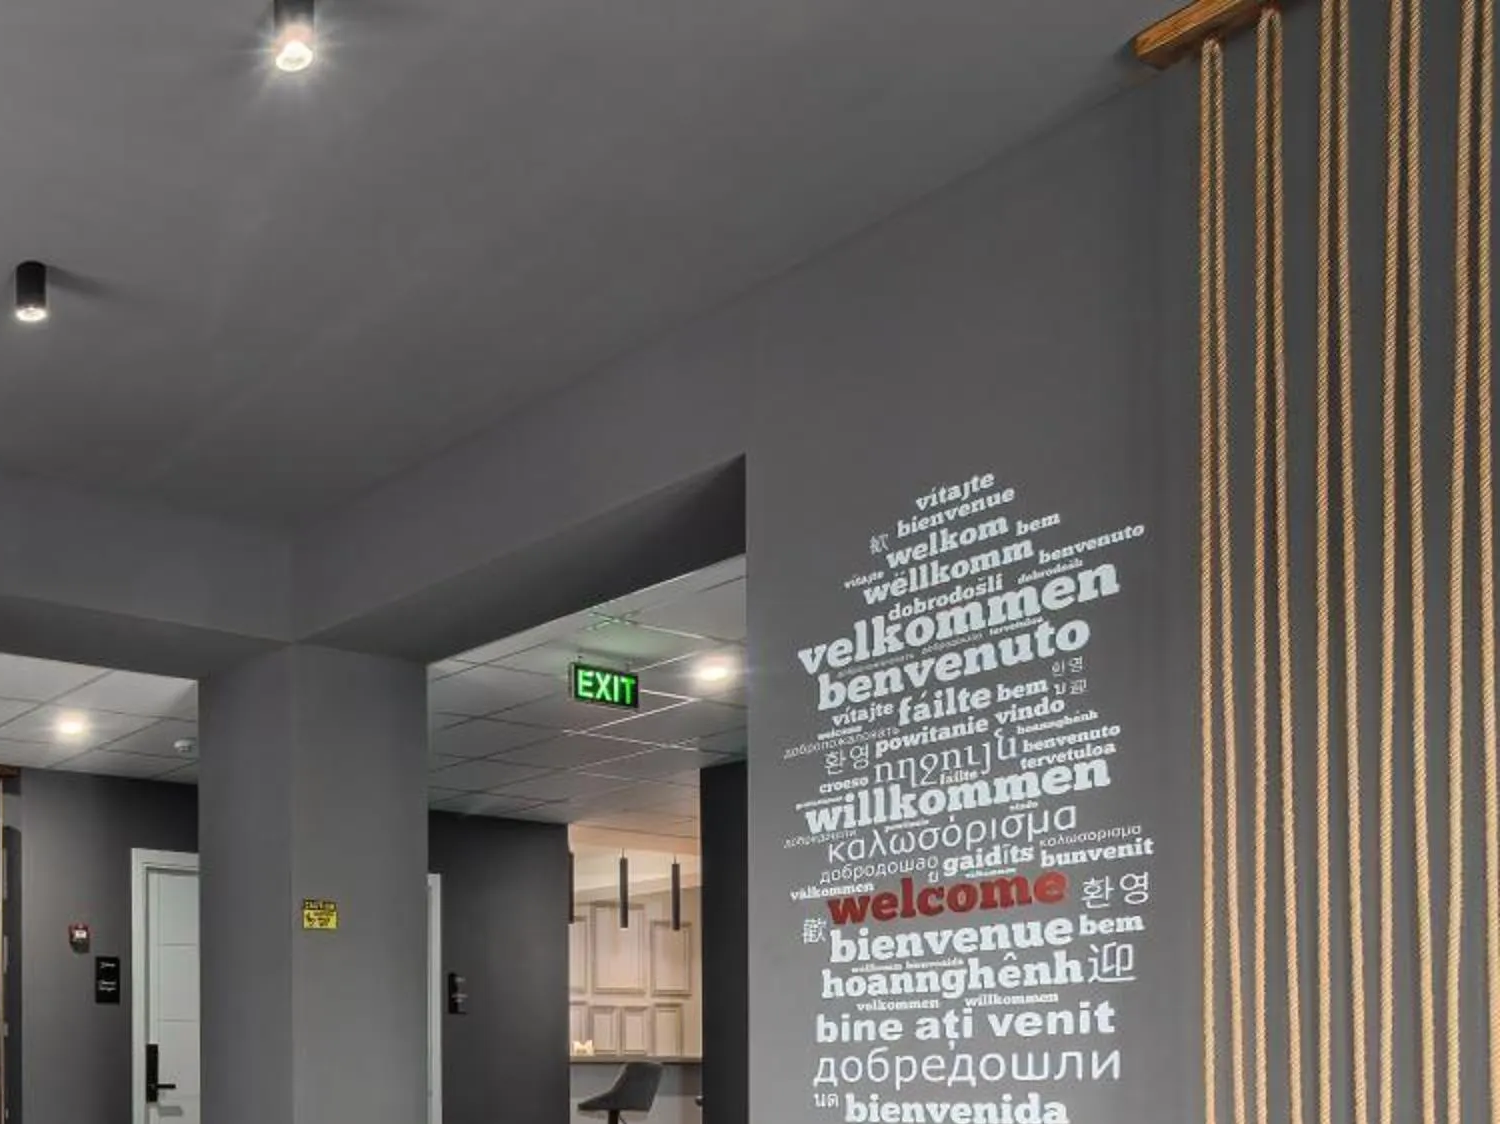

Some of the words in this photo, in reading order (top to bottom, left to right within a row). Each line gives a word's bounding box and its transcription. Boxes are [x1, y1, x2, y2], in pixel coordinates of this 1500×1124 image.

[897, 487, 1015, 538] bienvenue
[863, 540, 1034, 605] wëllkomm
[1038, 523, 1145, 565] benvenuto
[886, 516, 1008, 570] welkom
[1016, 512, 1060, 536] bem
[798, 563, 1120, 674] velkommen
[888, 575, 1003, 621] dobrodošli
[578, 669, 636, 705] EXIT
[818, 619, 1090, 710] benvenuto
[898, 683, 992, 727] fáilte
[997, 678, 1048, 703] bem
[875, 715, 989, 759] powitanie
[994, 696, 1065, 725] vindo
[1022, 725, 1121, 753] benvenuto
[1020, 742, 1116, 770] tervetuloa
[804, 758, 1111, 835] willkommen
[819, 776, 868, 794] croeso
[1040, 837, 1154, 869] bunvenit
[827, 871, 1069, 925] welcome
[829, 916, 1073, 963] bienvenue
[1078, 913, 1145, 936] bem
[1088, 942, 1136, 983] 迎
[821, 950, 1084, 999] hoannghênh
[816, 1013, 903, 1043] bine
[988, 1001, 1116, 1036] venit
[964, 993, 1058, 1007] willkommen
[813, 1046, 1121, 1090] добредошли
